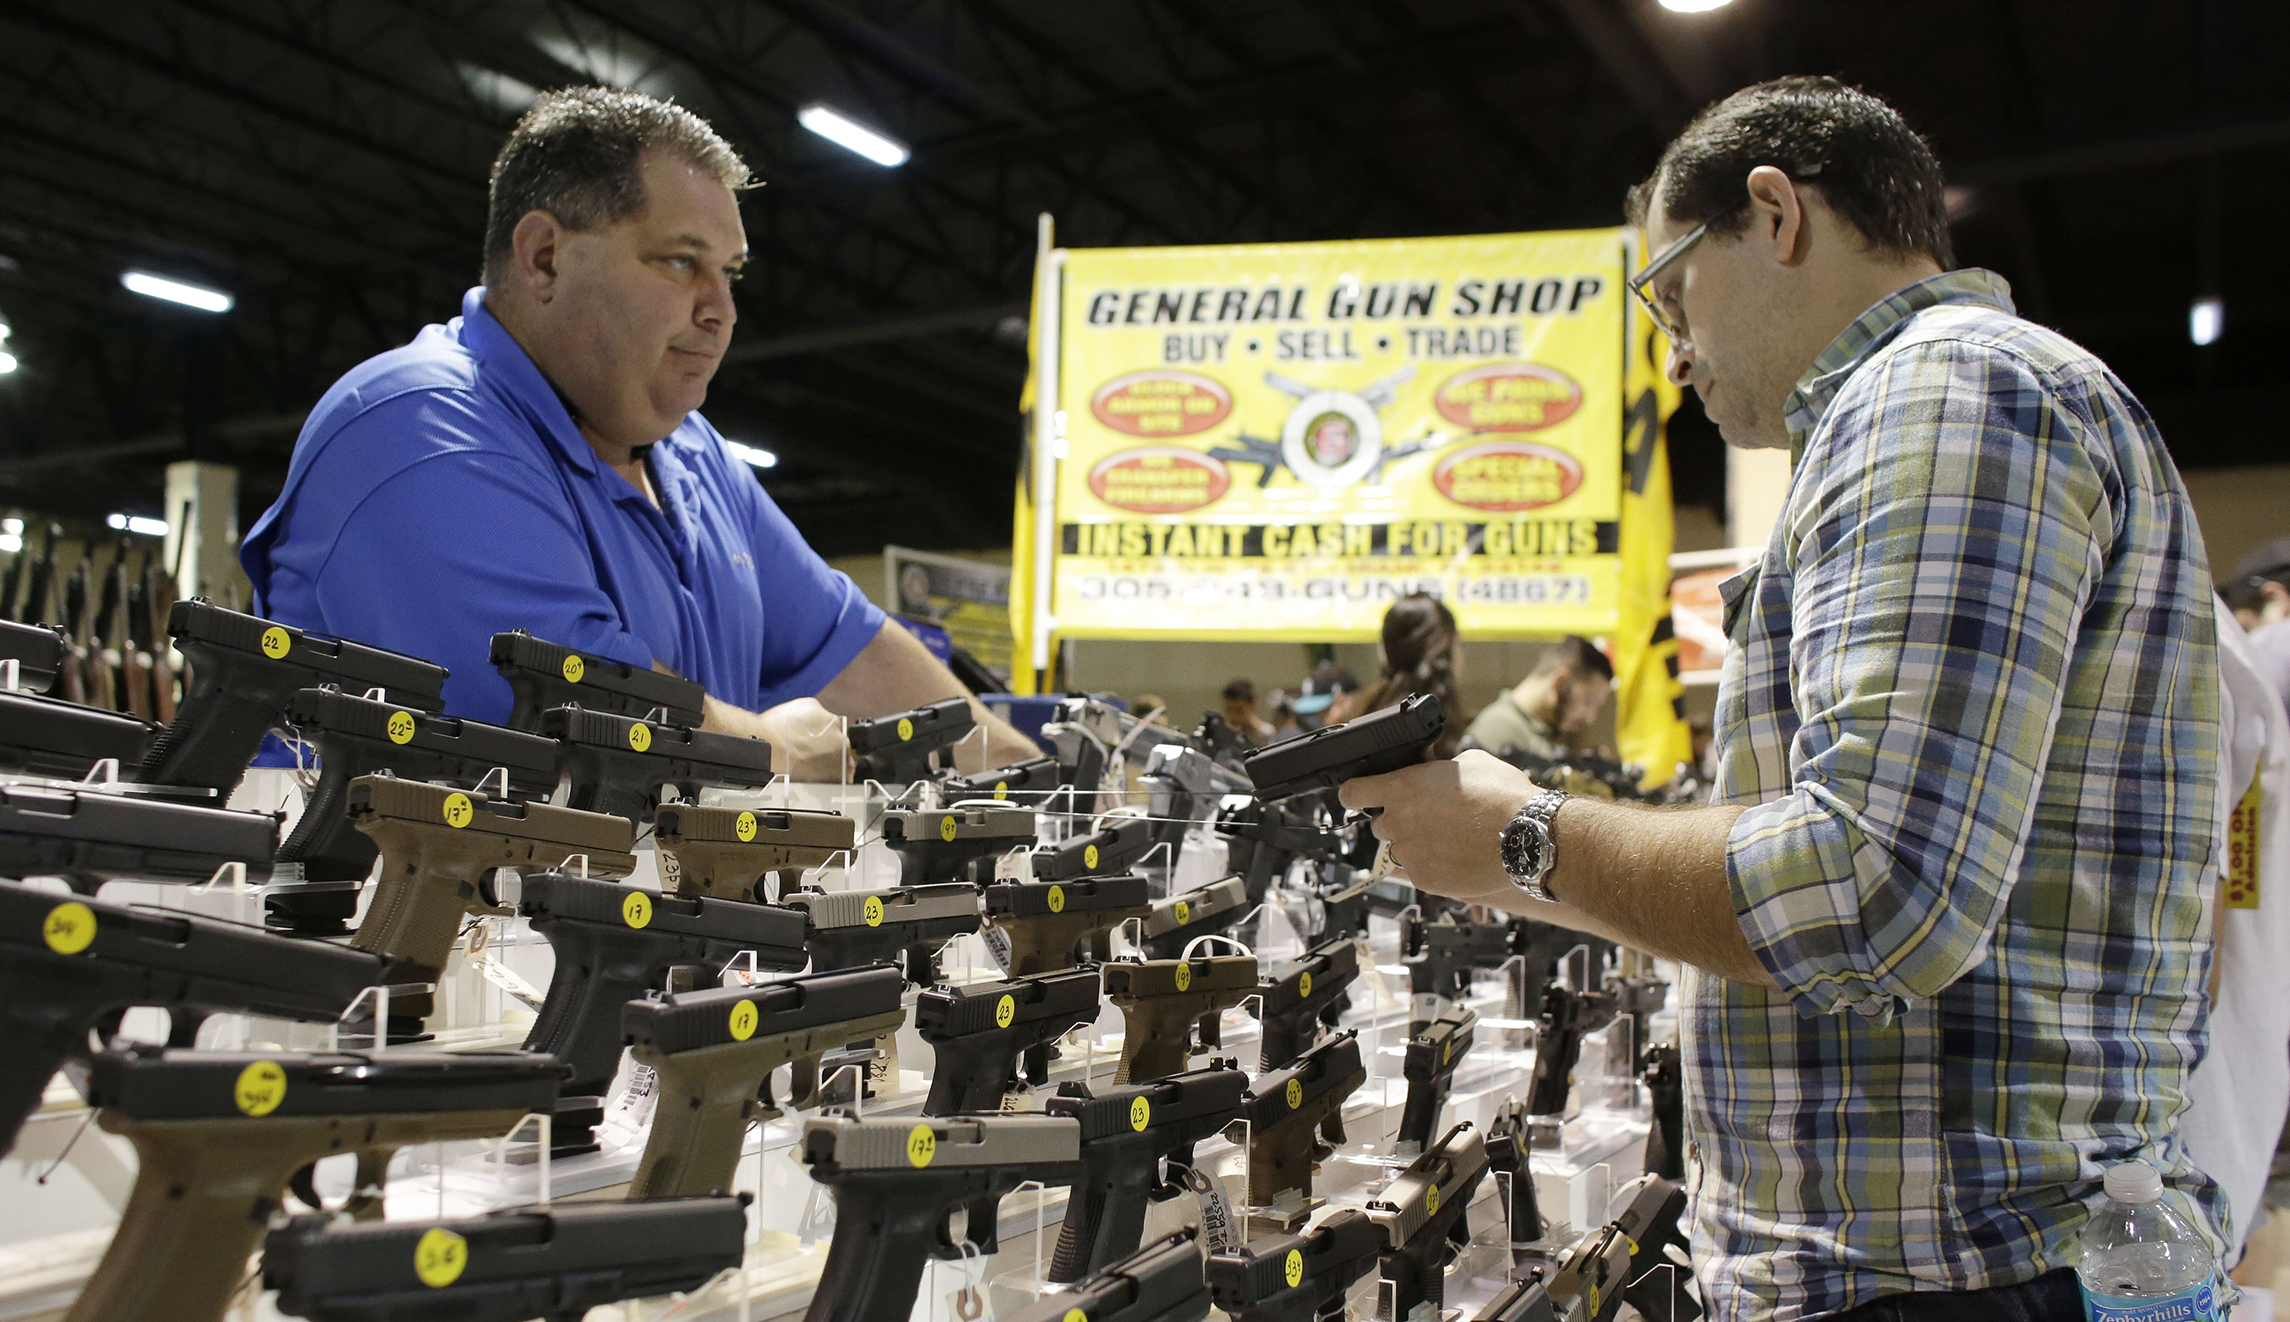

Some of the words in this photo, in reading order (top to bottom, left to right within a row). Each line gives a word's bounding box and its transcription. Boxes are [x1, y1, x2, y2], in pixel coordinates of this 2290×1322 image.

[1088, 288, 1307, 324] GENERAL
[1327, 284, 1437, 319] GUN
[1453, 279, 1601, 316] SHOP
[1164, 333, 1230, 363] BUY
[1277, 329, 1360, 359] SELL
[1406, 326, 1522, 356] TRADE
[1077, 523, 1249, 557] INSTANT
[1262, 523, 1373, 557] CASH
[1387, 521, 1468, 556] FOR
[1483, 519, 1599, 555] GUNS
[263, 635, 279, 650] 22
[632, 729, 644, 743] 21
[1051, 896, 1060, 909] 19
[866, 905, 878, 920] 23
[997, 1005, 1010, 1021] 23
[1132, 1107, 1145, 1124] 23
[2199, 1296, 2211, 1306] 1964
